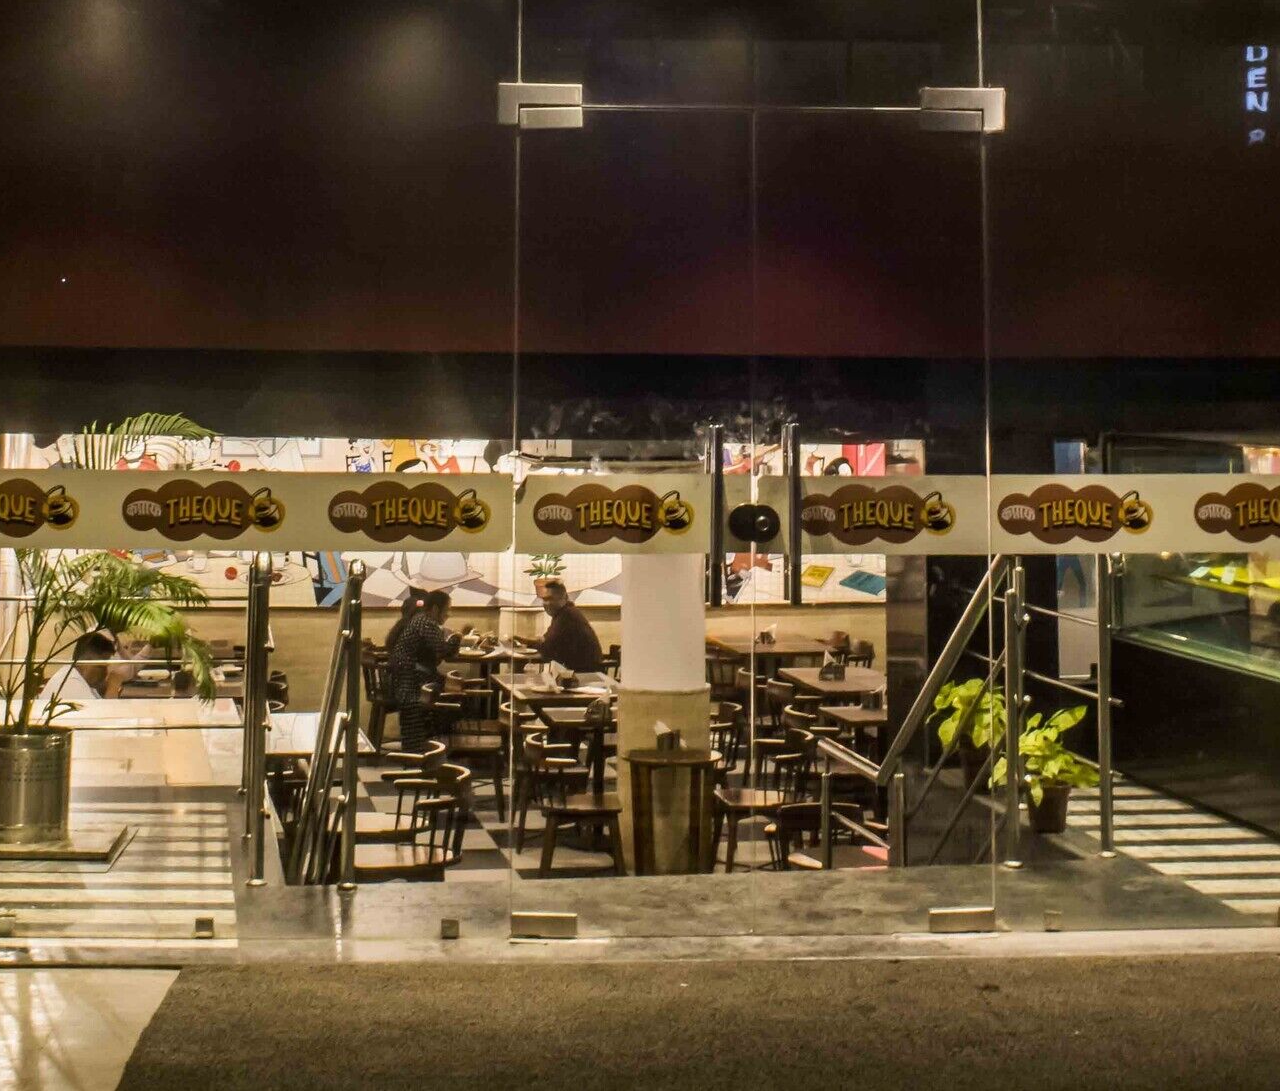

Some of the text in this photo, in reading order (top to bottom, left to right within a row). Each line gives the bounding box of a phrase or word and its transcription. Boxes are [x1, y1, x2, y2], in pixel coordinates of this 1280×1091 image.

[166, 495, 244, 527] THEQUE
[371, 497, 450, 530] THEQUE
[576, 499, 653, 531] THEQUE
[838, 499, 916, 532] THEQUE
[1038, 499, 1113, 531] THEQUE
